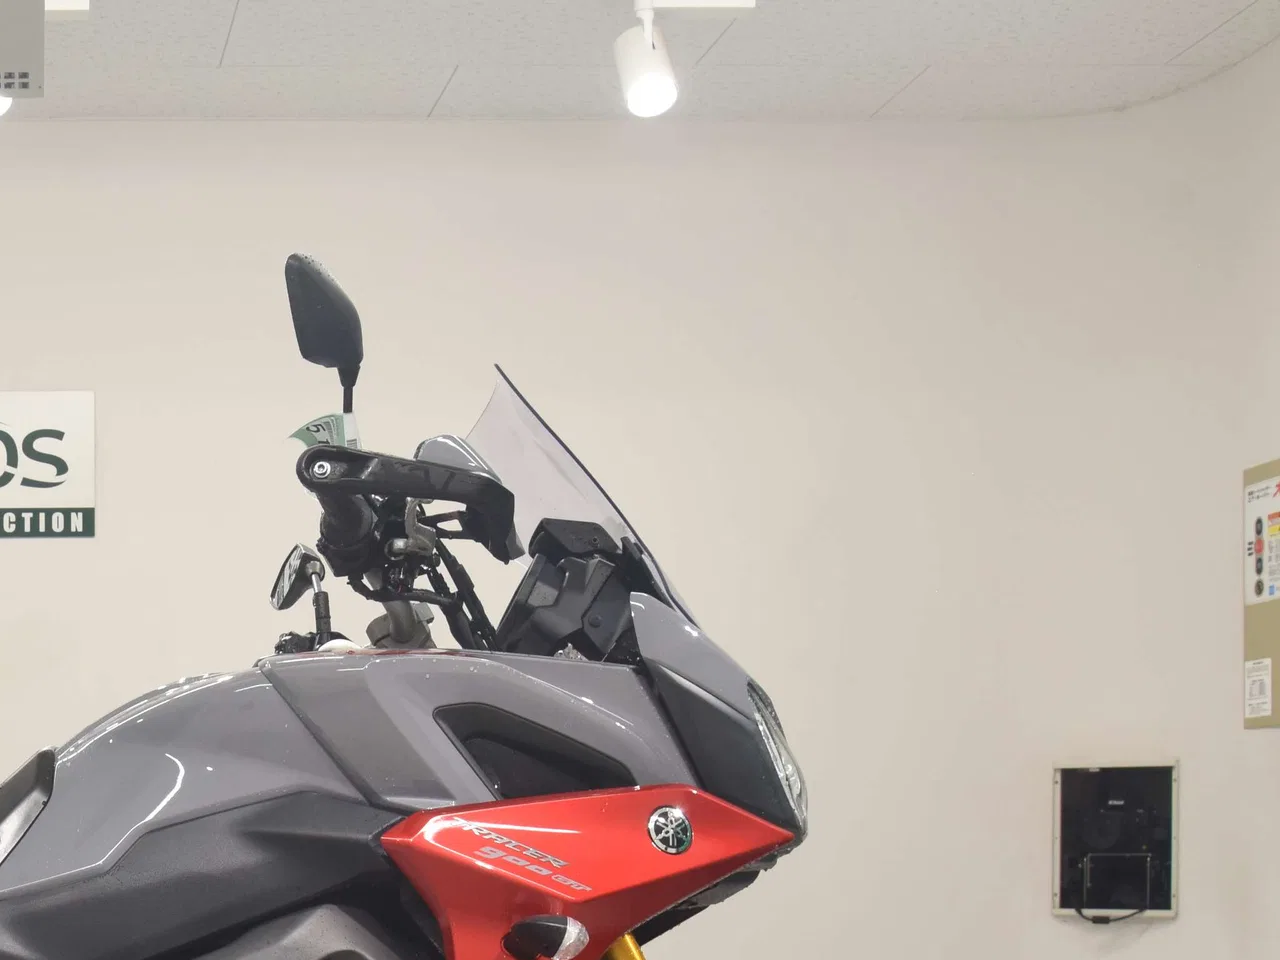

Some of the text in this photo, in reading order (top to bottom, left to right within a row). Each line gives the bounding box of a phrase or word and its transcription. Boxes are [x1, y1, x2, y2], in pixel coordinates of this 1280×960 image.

[452, 816, 569, 868] TRACER
[474, 846, 593, 892] 900 GT
